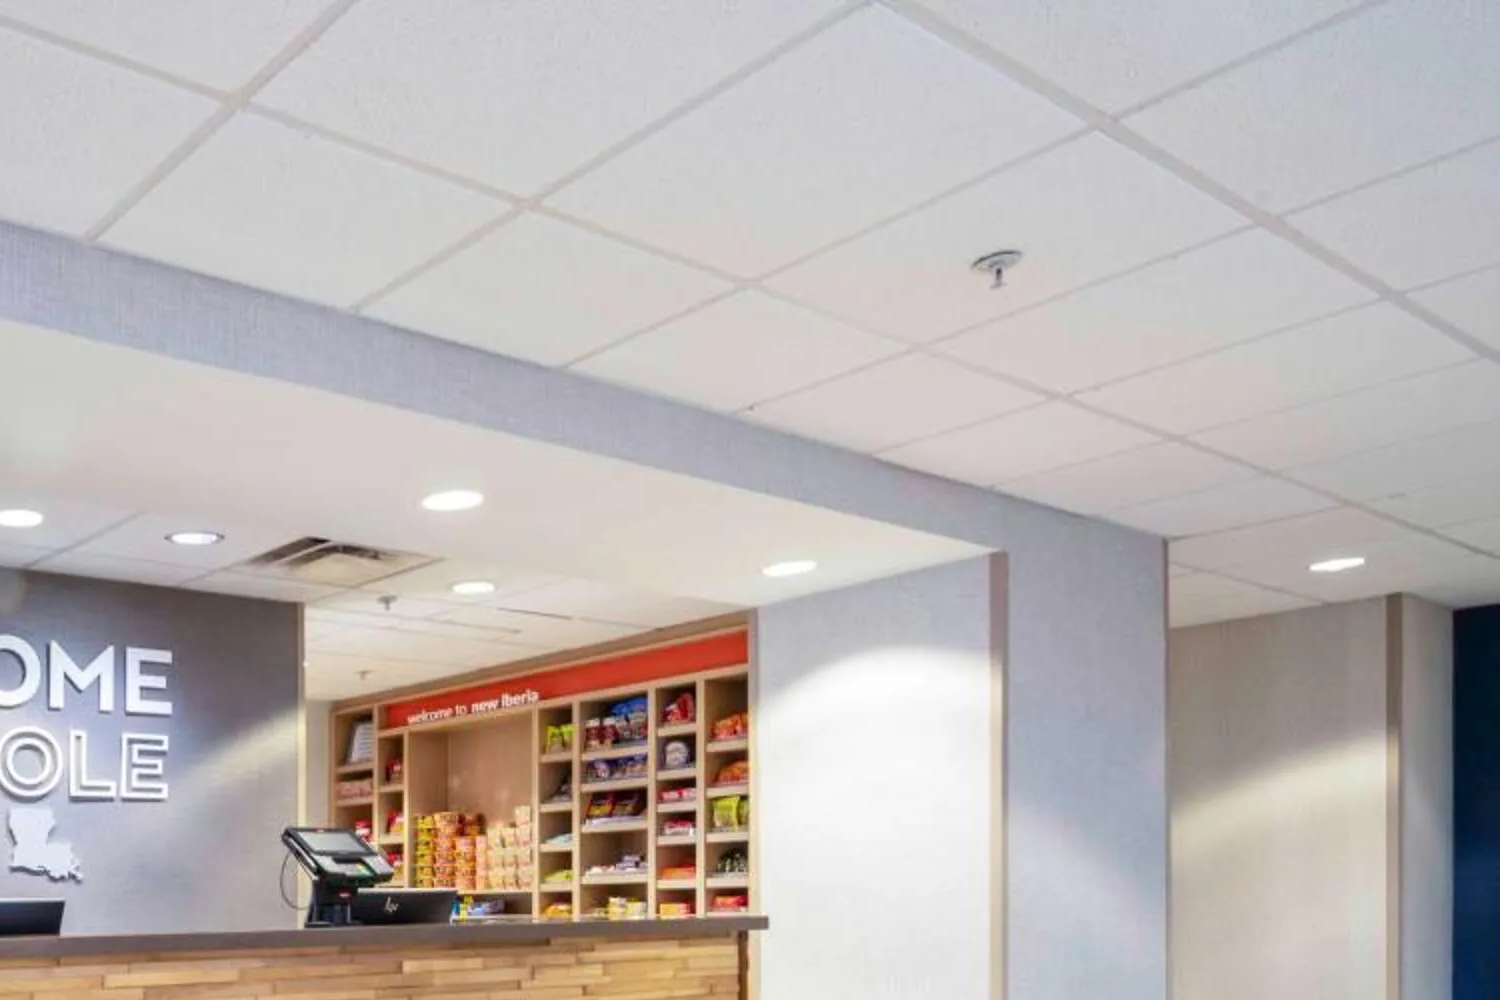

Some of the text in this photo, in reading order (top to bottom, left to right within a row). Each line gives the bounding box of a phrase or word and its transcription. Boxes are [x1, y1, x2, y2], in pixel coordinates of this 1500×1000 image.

[407, 706, 453, 723] welcome
[456, 703, 468, 715] to
[471, 699, 500, 713] new
